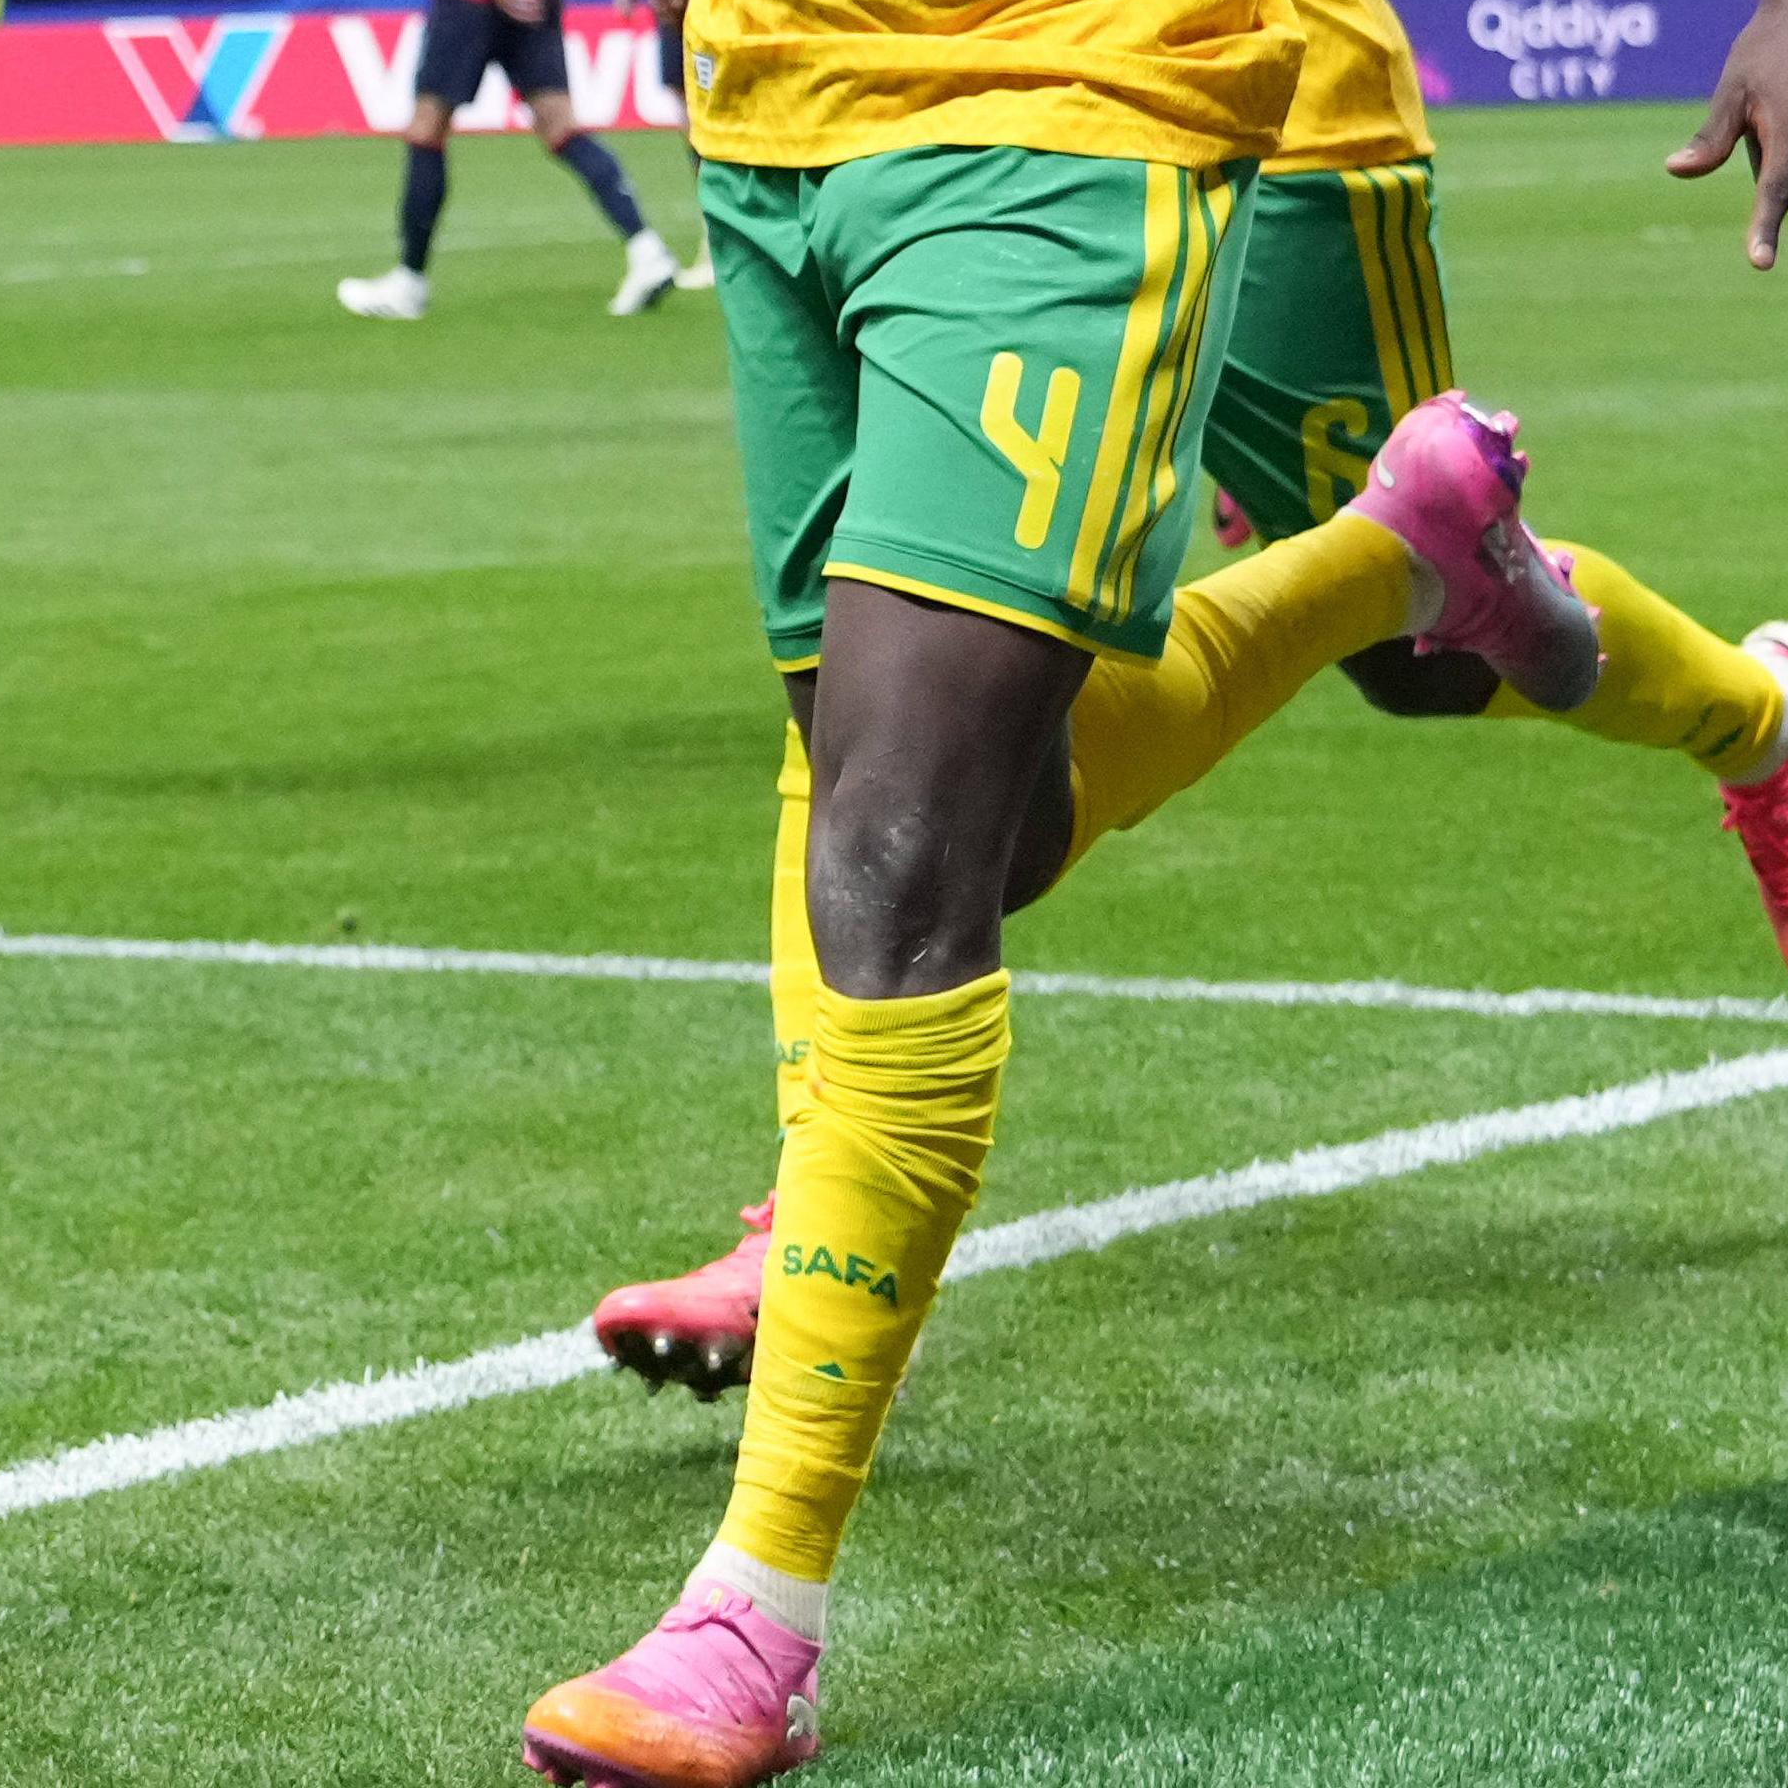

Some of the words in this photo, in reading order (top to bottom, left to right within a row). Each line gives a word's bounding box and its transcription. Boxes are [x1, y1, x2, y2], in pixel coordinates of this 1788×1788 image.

[1509, 58, 1618, 101] CITY
[979, 351, 1081, 550] 4
[782, 1242, 899, 1309] SAFA
